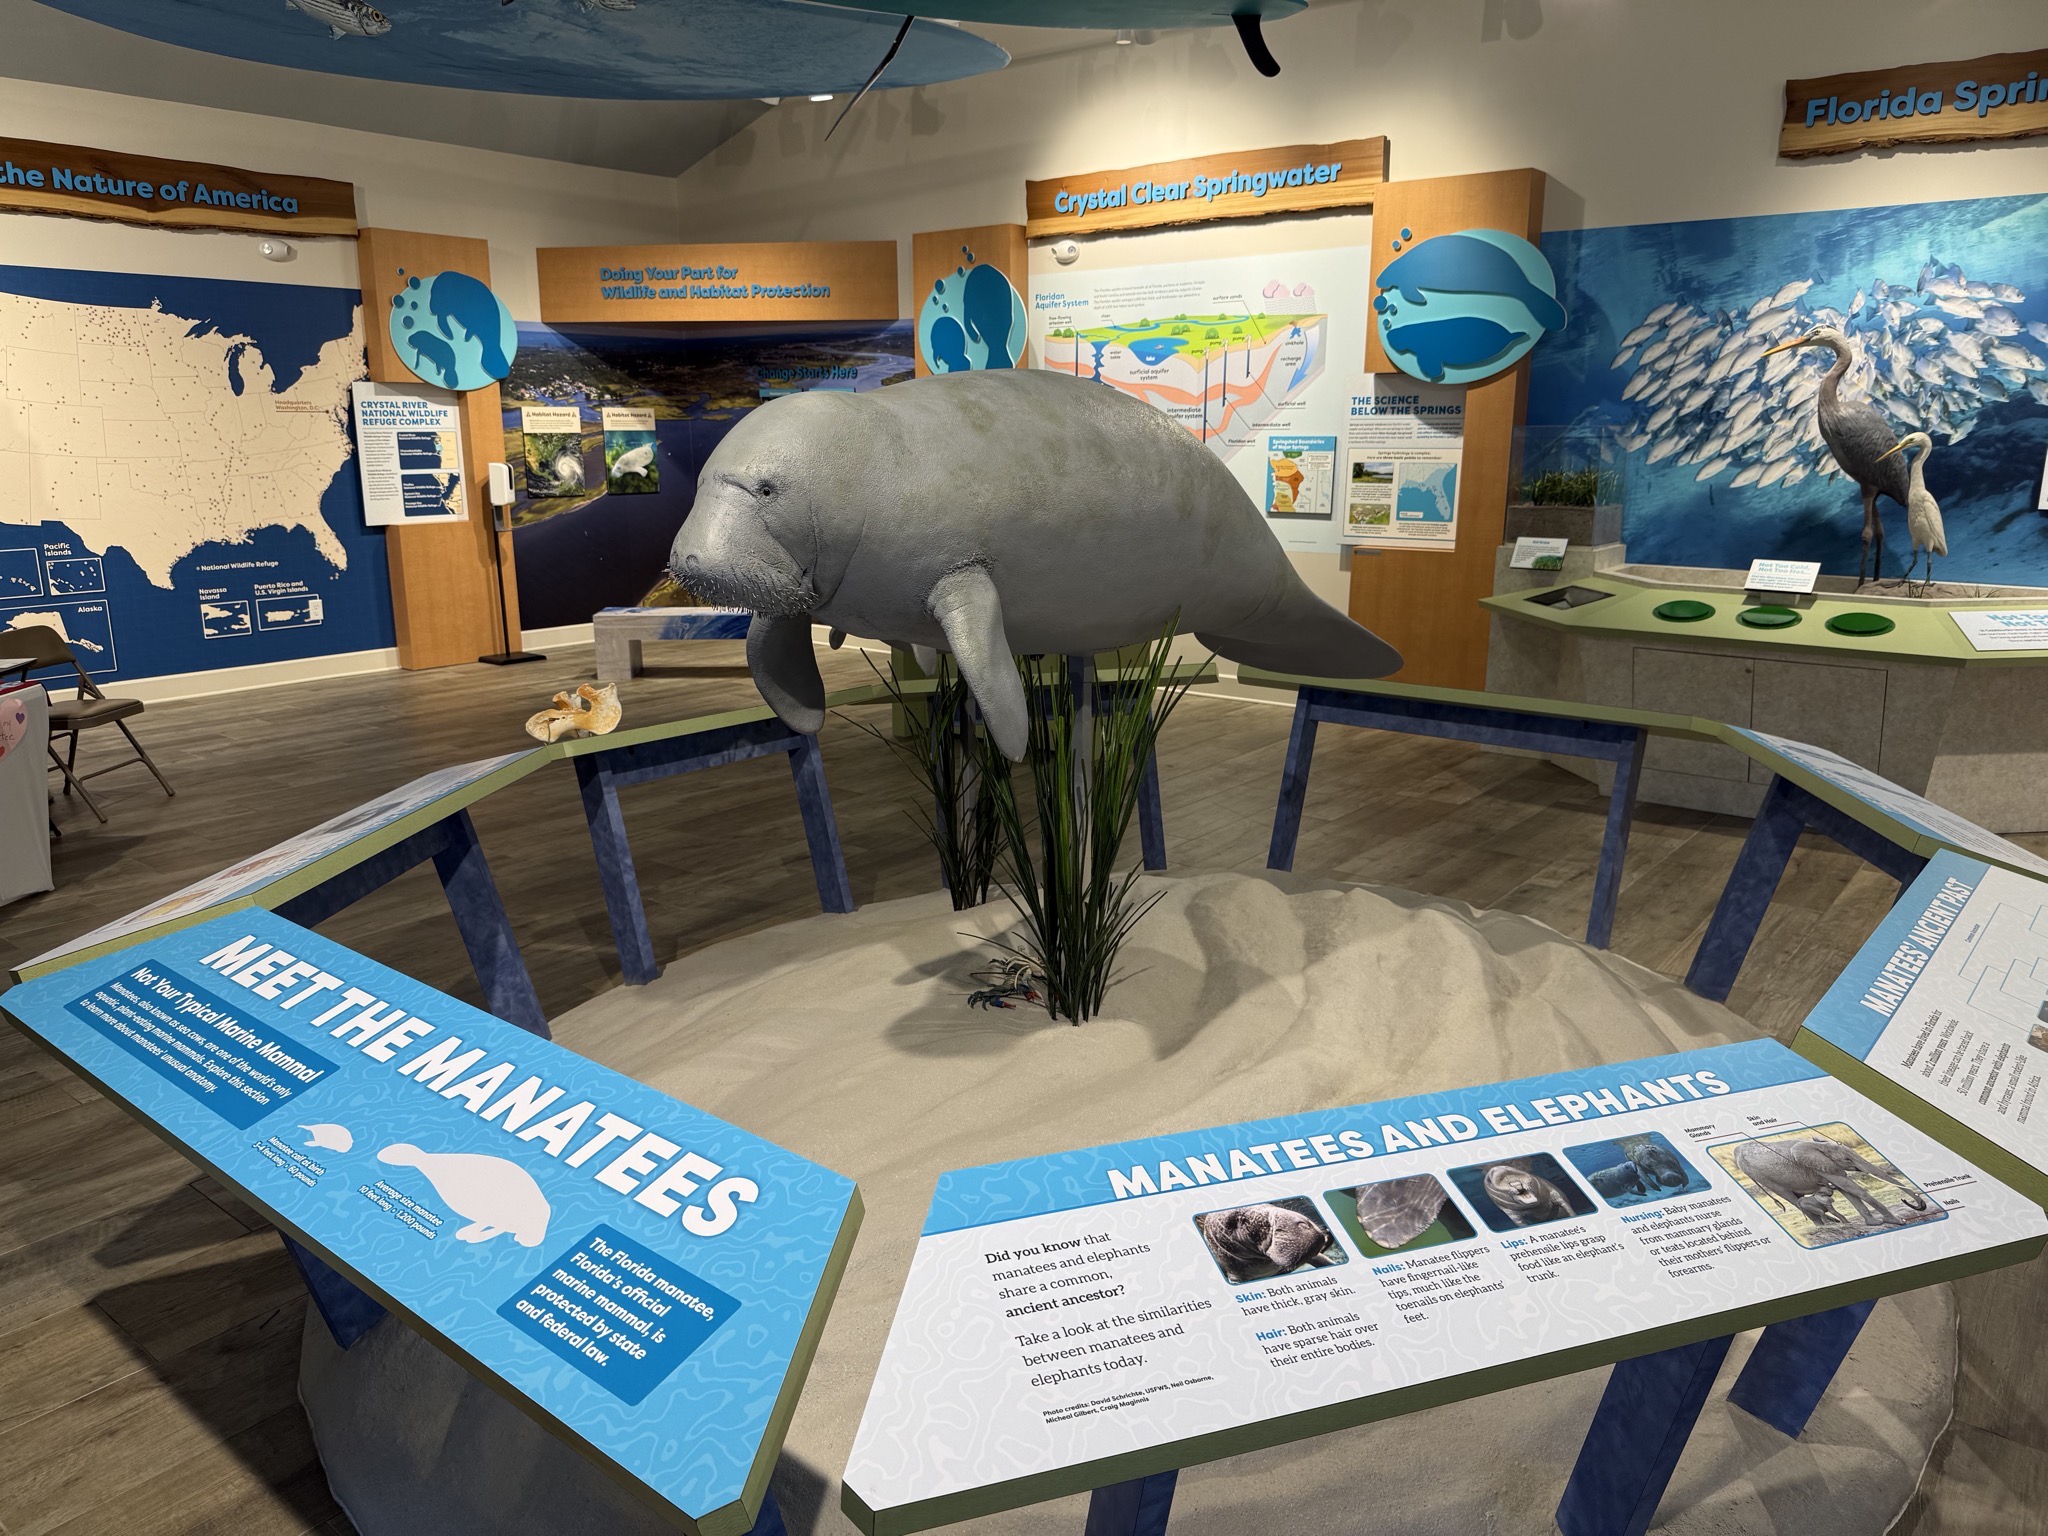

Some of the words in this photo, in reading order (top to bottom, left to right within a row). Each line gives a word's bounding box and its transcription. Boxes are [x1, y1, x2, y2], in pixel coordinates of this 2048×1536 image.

[1806, 86, 1943, 128] Florida
[51, 166, 154, 199] Nature
[160, 180, 189, 202] of
[194, 183, 299, 213] America
[1055, 185, 1127, 217] Crystal
[1131, 180, 1191, 204] Clear
[1192, 163, 1342, 202] Springwater
[600, 268, 643, 283] Doing
[645, 268, 679, 280] Your
[681, 267, 714, 280] Part
[716, 266, 738, 279] for
[601, 286, 656, 299] Wildlife
[658, 285, 687, 298] and
[690, 285, 748, 299] Habitat
[751, 284, 831, 298] Protection
[1035, 293, 1064, 301] Floridan
[1035, 301, 1061, 311] Aquifer
[1063, 299, 1089, 308] System
[797, 366, 829, 379] Starts
[831, 365, 858, 379] Here
[1351, 407, 1388, 415] BELOW
[1391, 407, 1410, 415] THE
[1413, 406, 1461, 415] SPRINGS
[1352, 397, 1371, 405] THE
[1374, 396, 1419, 405] SCIENCE
[1859, 940, 1930, 1018] MANATEES'
[1908, 898, 1958, 950] ANCIENT
[1936, 876, 1974, 907] PAST
[130, 967, 160, 986] Not
[151, 978, 182, 1000] Your
[174, 992, 226, 1024] Typical
[213, 1016, 262, 1050] Marine
[255, 1042, 325, 1084] Mammal
[199, 934, 346, 1011] MEET
[309, 987, 436, 1064] THE
[396, 1035, 760, 1237] MANATEES
[1107, 1130, 1374, 1201] MANATEES
[1383, 1114, 1478, 1154] AND
[1477, 1070, 1732, 1140] ELEPHANTS
[1683, 1123, 1716, 1135] Mammary
[1689, 1130, 1712, 1139] Glands
[268, 1136, 294, 1155] Manatee
[291, 1153, 307, 1161] calf
[308, 1162, 325, 1176] birth
[365, 1190, 380, 1201] feet
[377, 1197, 392, 1211] long
[396, 1210, 415, 1224] 1,200
[409, 1222, 436, 1239] pounds
[375, 1181, 402, 1199] Average
[400, 1197, 415, 1207] size
[412, 1205, 443, 1226] manatee
[984, 1250, 1012, 1264] Did
[1013, 1245, 1040, 1260] you
[1041, 1238, 1082, 1254] know
[1083, 1231, 1111, 1246] that
[992, 1260, 1058, 1282] manatees
[1059, 1255, 1085, 1270] and
[1086, 1242, 1151, 1266] elephants
[589, 1237, 613, 1257] The
[610, 1250, 657, 1283] Florida
[652, 1277, 715, 1322] manatee,
[998, 1282, 1037, 1299] share
[1039, 1282, 1048, 1292] a
[1049, 1269, 1113, 1290] common,
[1235, 1290, 1267, 1304] Skin:
[1267, 1284, 1294, 1298] Both
[1295, 1276, 1338, 1294] animals
[552, 1268, 596, 1300] marine
[593, 1294, 655, 1337] mammal,
[651, 1327, 667, 1344] is
[620, 1284, 672, 1318] official
[1005, 1299, 1059, 1318] ancient
[1061, 1284, 1126, 1307] ancestor?
[1241, 1303, 1270, 1317] have
[1271, 1296, 1304, 1311] thick,
[1304, 1291, 1328, 1306] gray
[1329, 1287, 1356, 1300] skin.
[515, 1298, 541, 1320] and
[538, 1313, 586, 1353] federal
[581, 1340, 608, 1367] law.
[530, 1283, 599, 1327] protected
[592, 1318, 613, 1339] by
[609, 1331, 647, 1360] state
